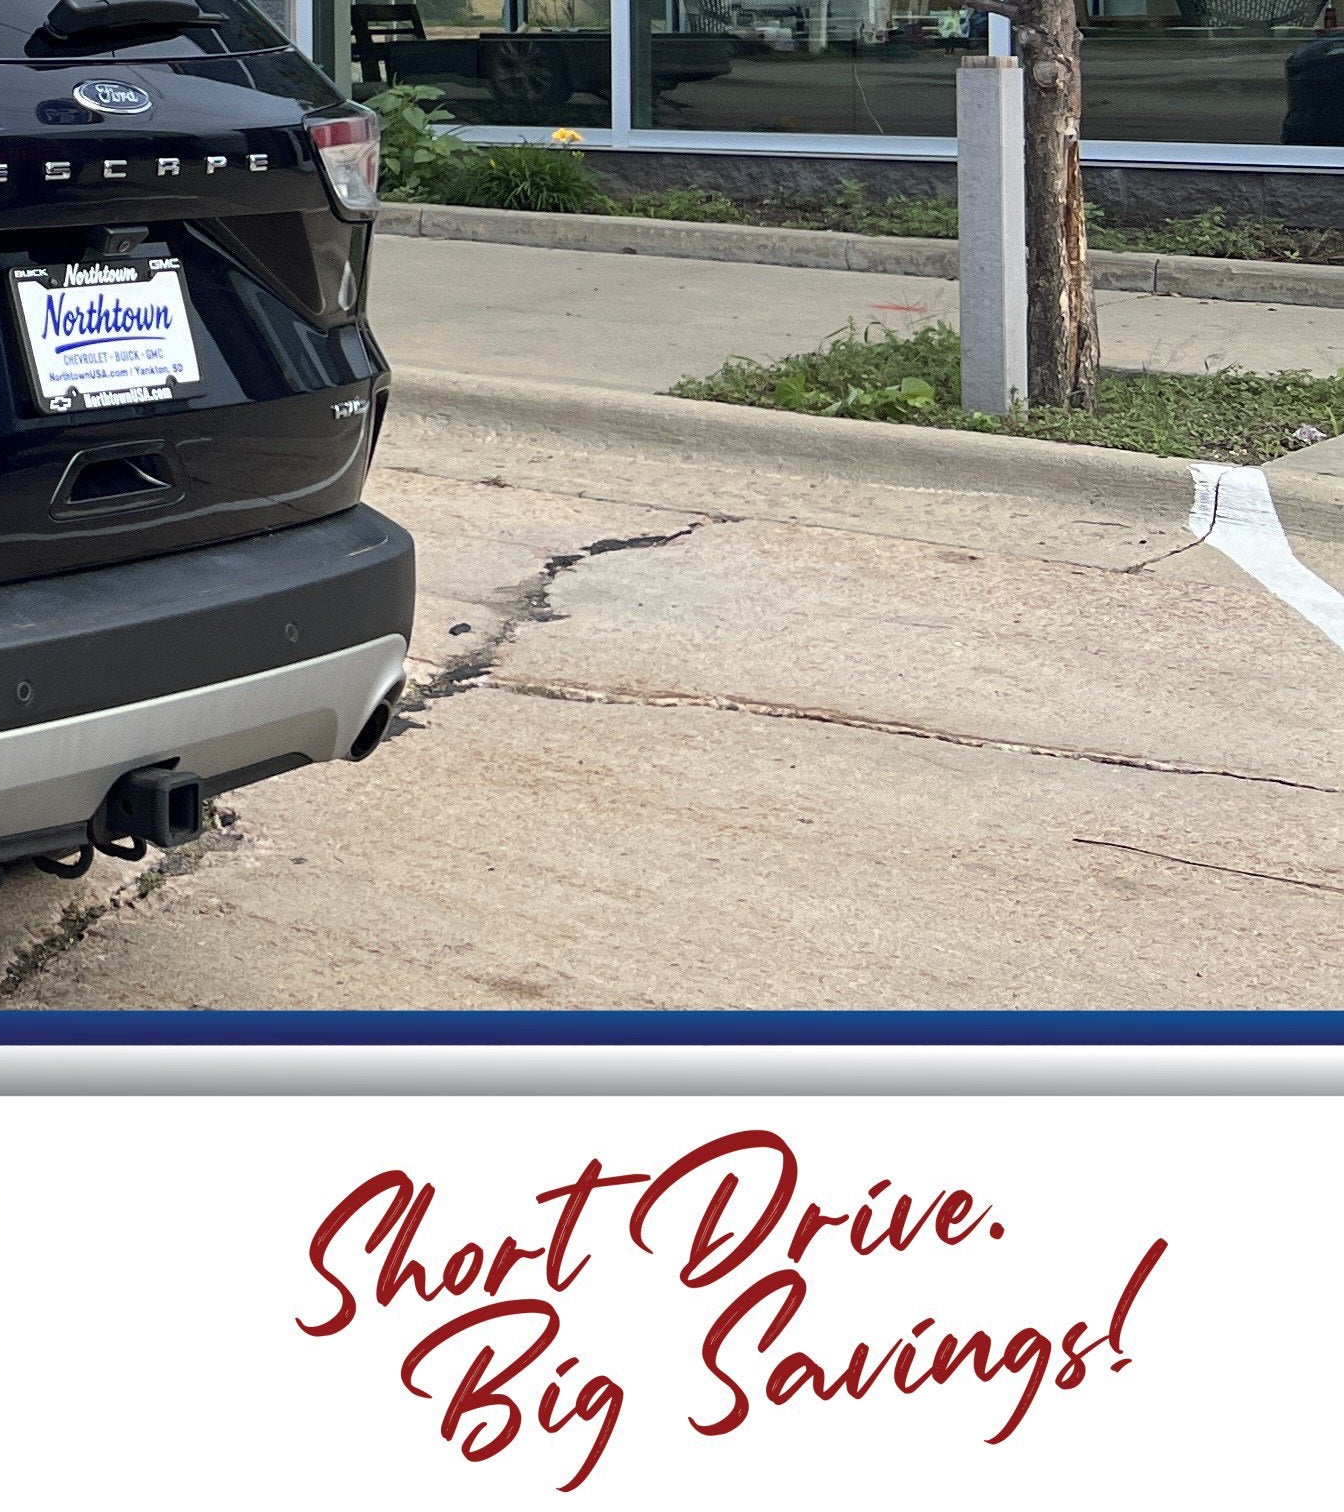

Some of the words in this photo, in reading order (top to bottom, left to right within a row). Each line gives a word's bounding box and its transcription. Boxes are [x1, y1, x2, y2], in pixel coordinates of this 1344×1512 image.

[95, 84, 138, 103] Ford
[14, 268, 48, 278] BUICK
[64, 263, 138, 287] Northtown
[149, 258, 180, 270] GMC
[42, 292, 173, 339] Northtown
[63, 351, 108, 366] CHEVROLET
[115, 349, 140, 362] BUICK
[145, 348, 164, 359] GMC
[49, 368, 128, 382] NorthtownUSA.com
[83, 386, 172, 409] NorthtownUSA.com
